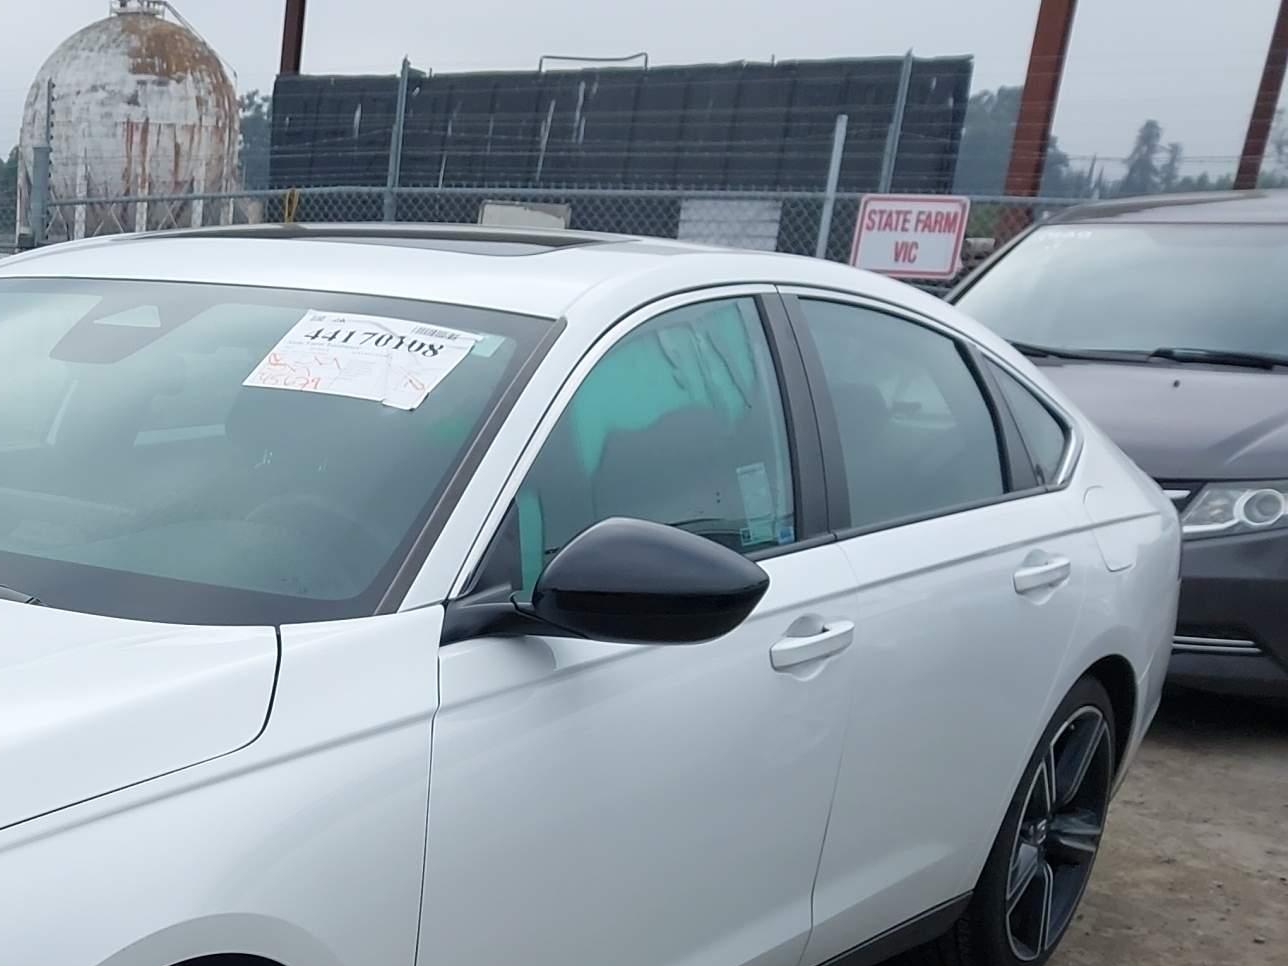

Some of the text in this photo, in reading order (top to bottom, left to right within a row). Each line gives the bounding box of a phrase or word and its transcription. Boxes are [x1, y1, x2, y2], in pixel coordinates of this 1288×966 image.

[865, 209, 959, 233] STATE FARM
[893, 241, 919, 264] VIC
[304, 328, 445, 358] 44170108
